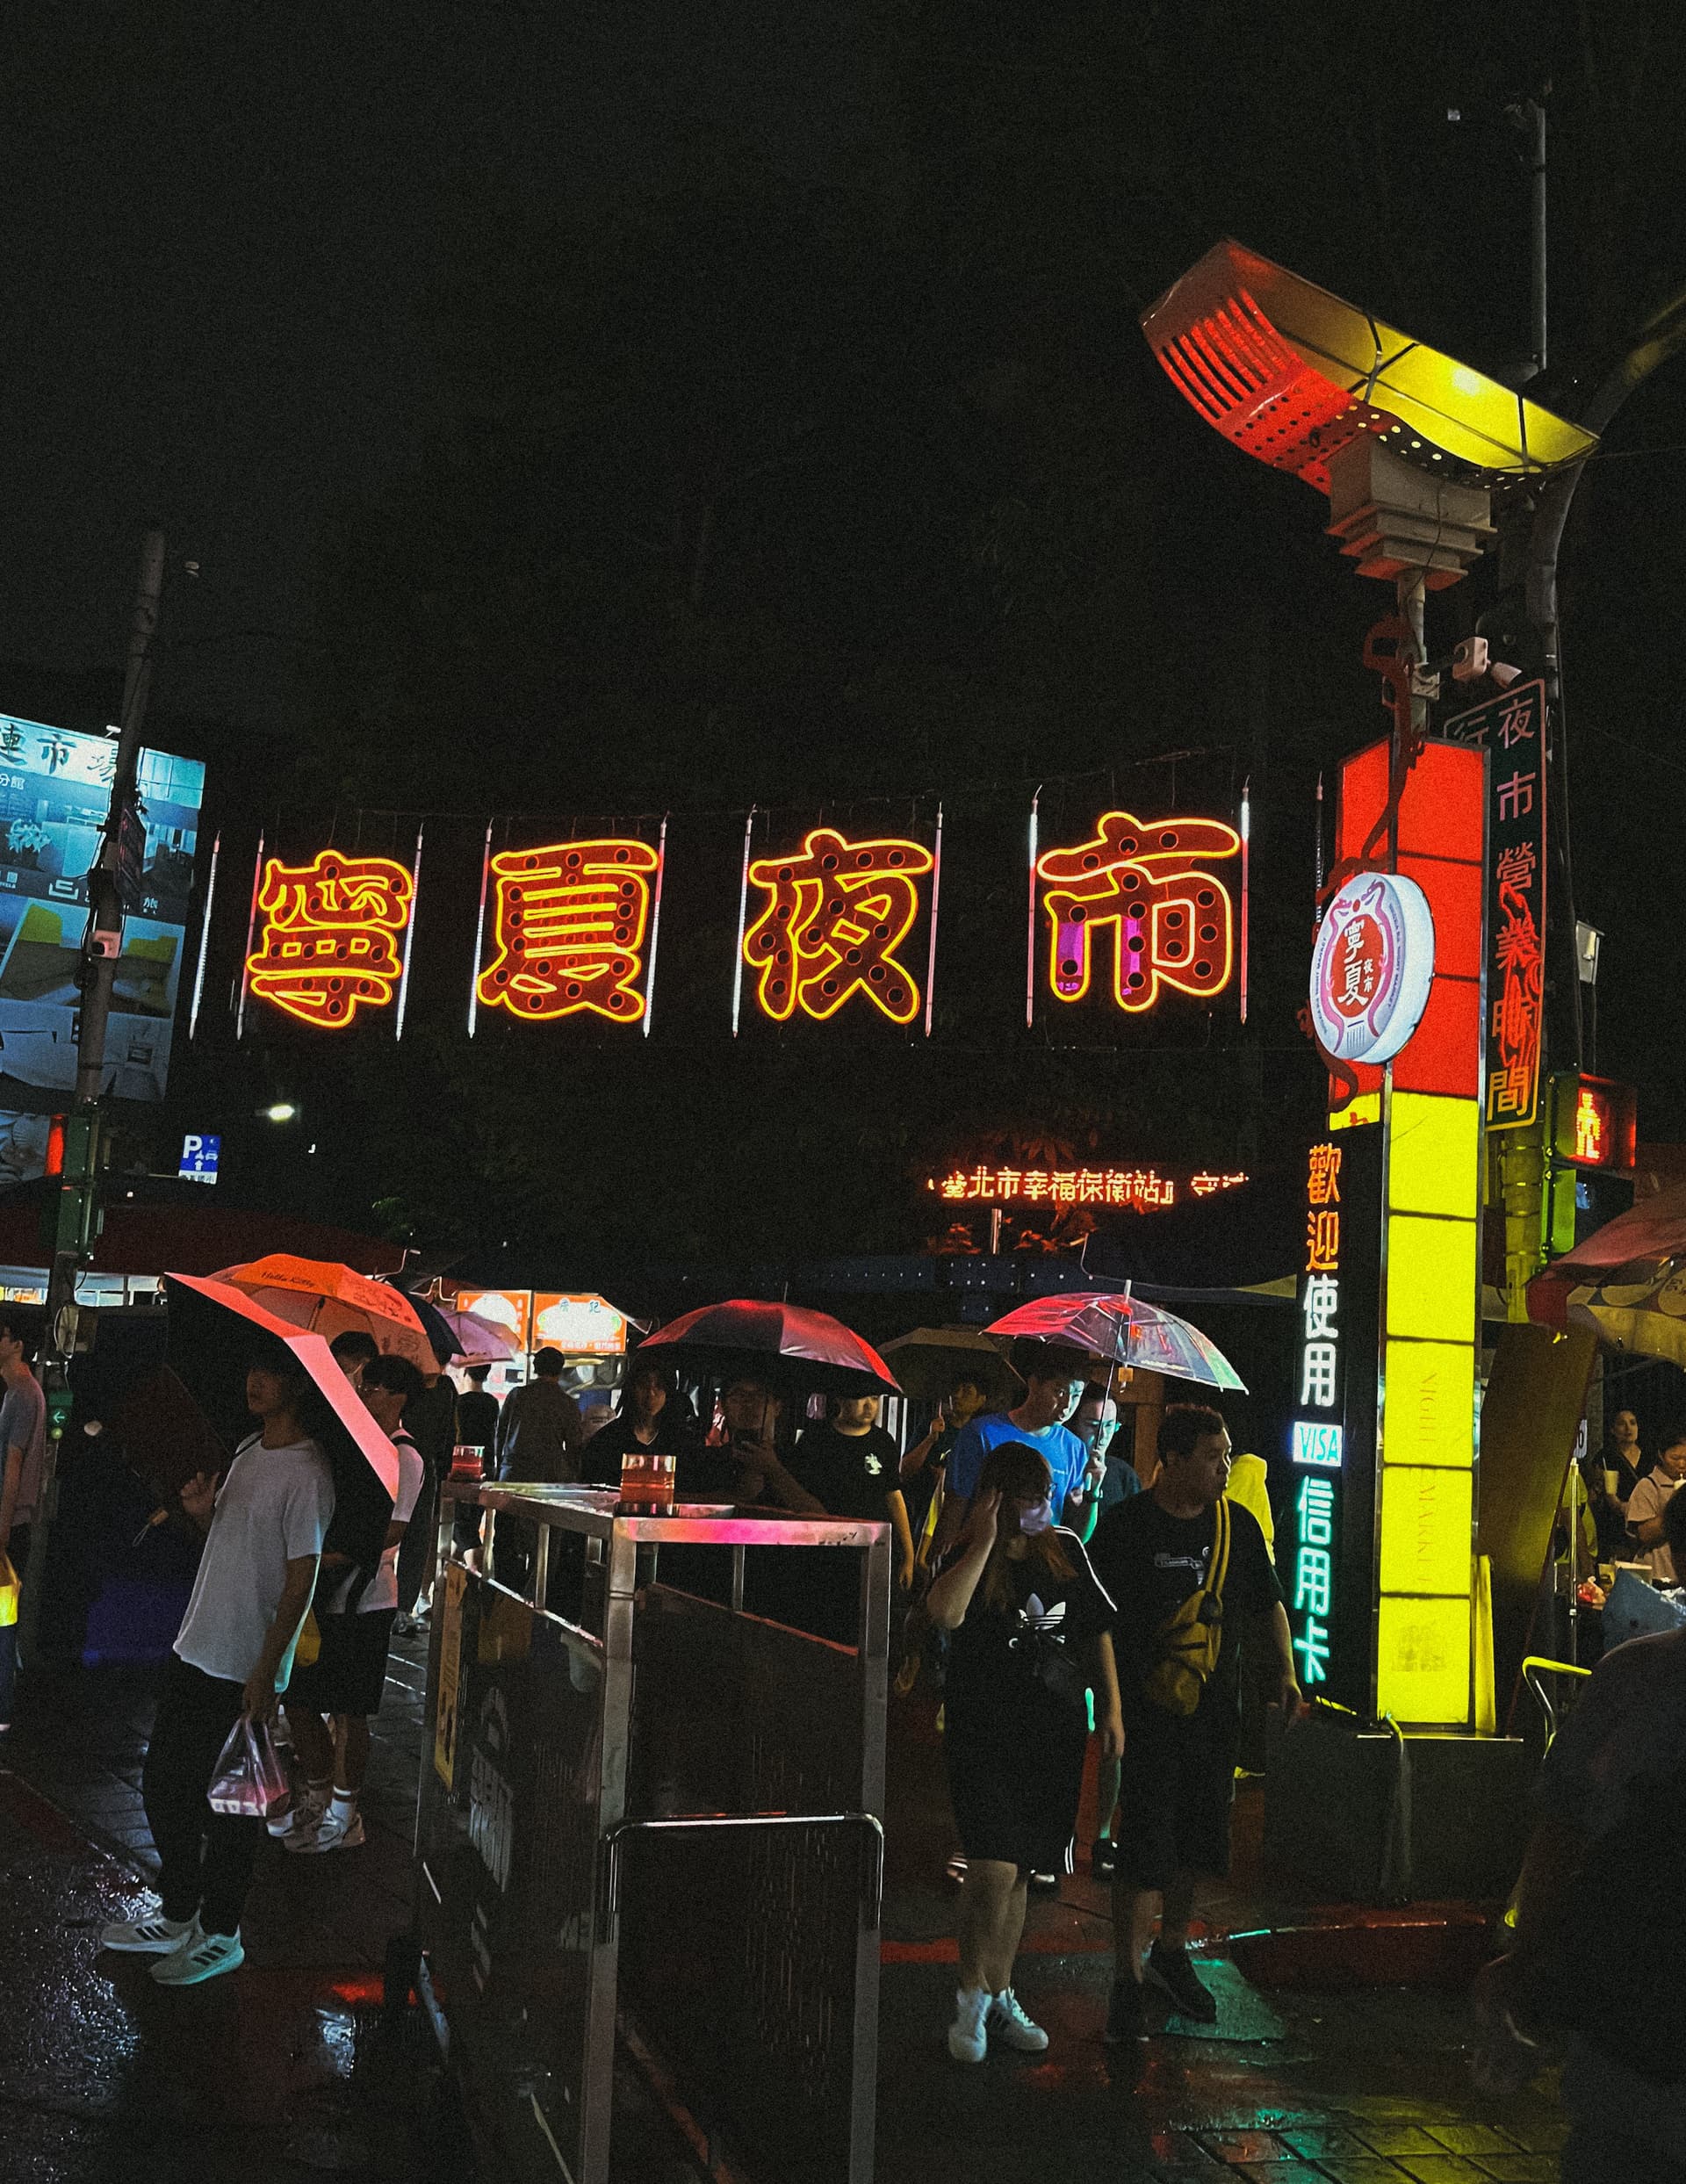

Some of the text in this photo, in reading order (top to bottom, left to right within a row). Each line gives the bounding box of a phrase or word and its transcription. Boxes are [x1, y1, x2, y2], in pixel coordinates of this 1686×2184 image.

[1337, 919, 1369, 1006] 寧夏
[183, 1135, 203, 1159] P
[261, 1270, 287, 1282] Hello
[1301, 1142, 1342, 1407] 歡迎使用
[1299, 1425, 1339, 1461] VISA
[1293, 1474, 1334, 1685] 信用卡
